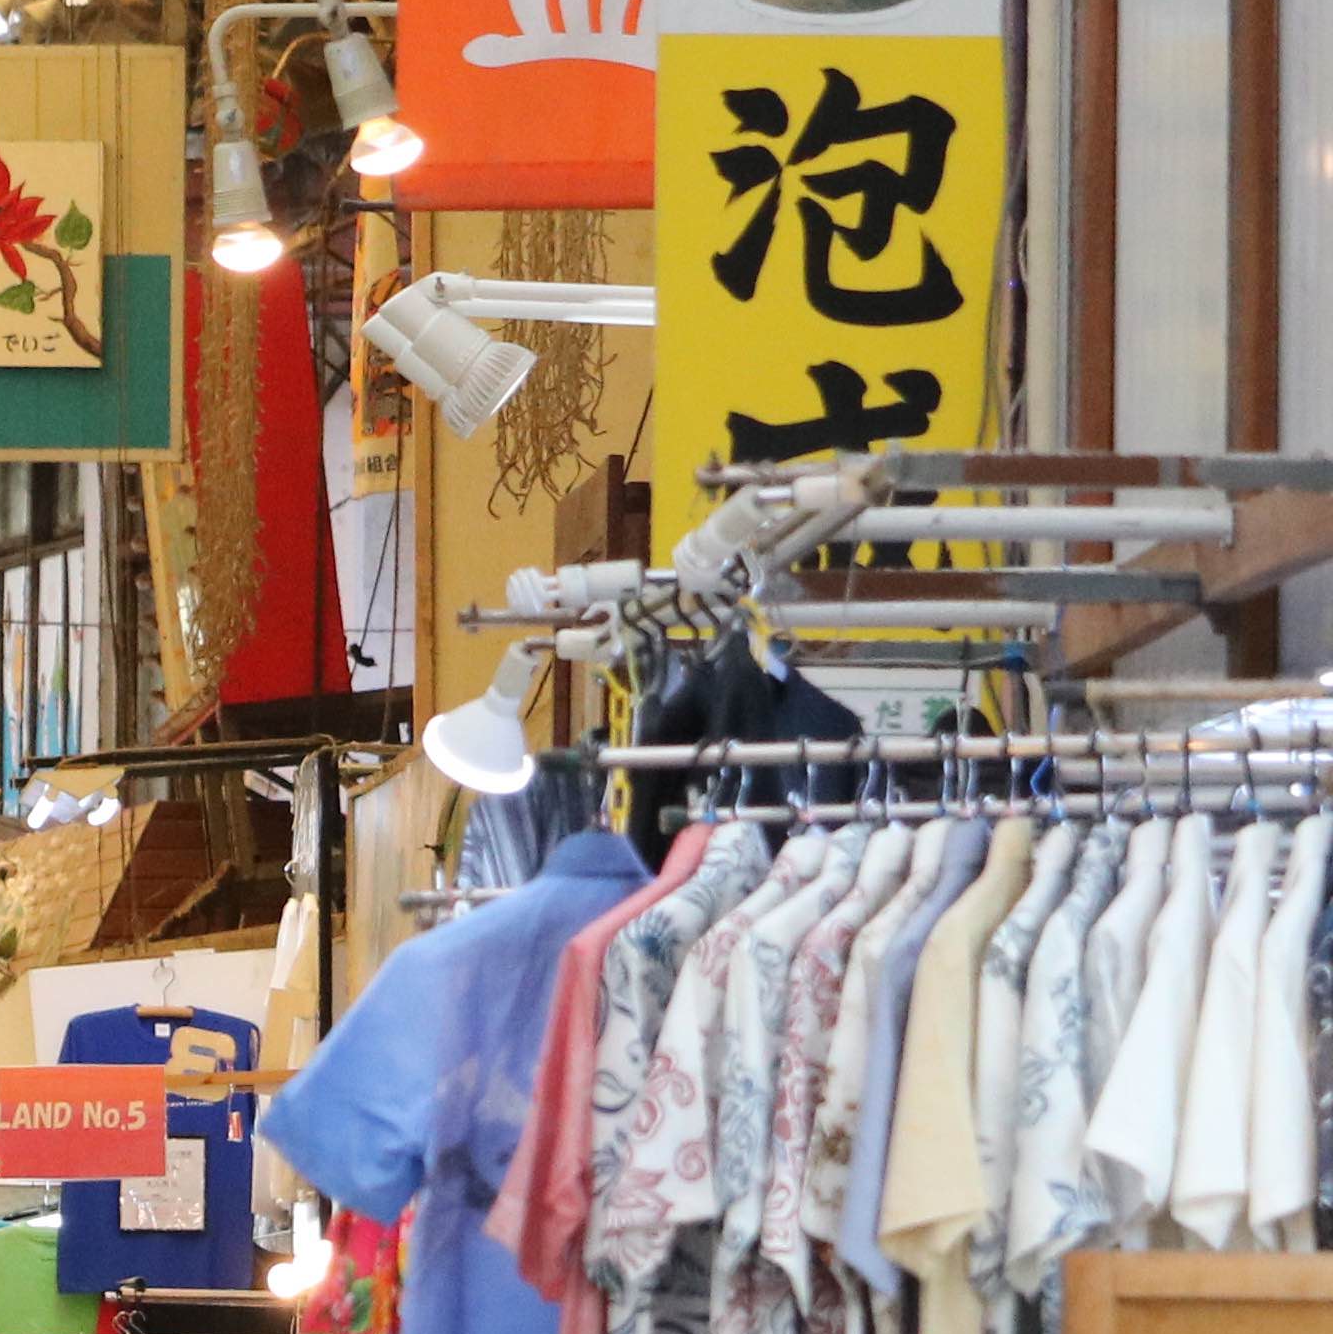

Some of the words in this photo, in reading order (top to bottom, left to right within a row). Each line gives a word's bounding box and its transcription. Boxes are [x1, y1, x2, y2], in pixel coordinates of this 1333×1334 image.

[2, 332, 62, 353] でいご
[82, 1101, 147, 1131] No.5
